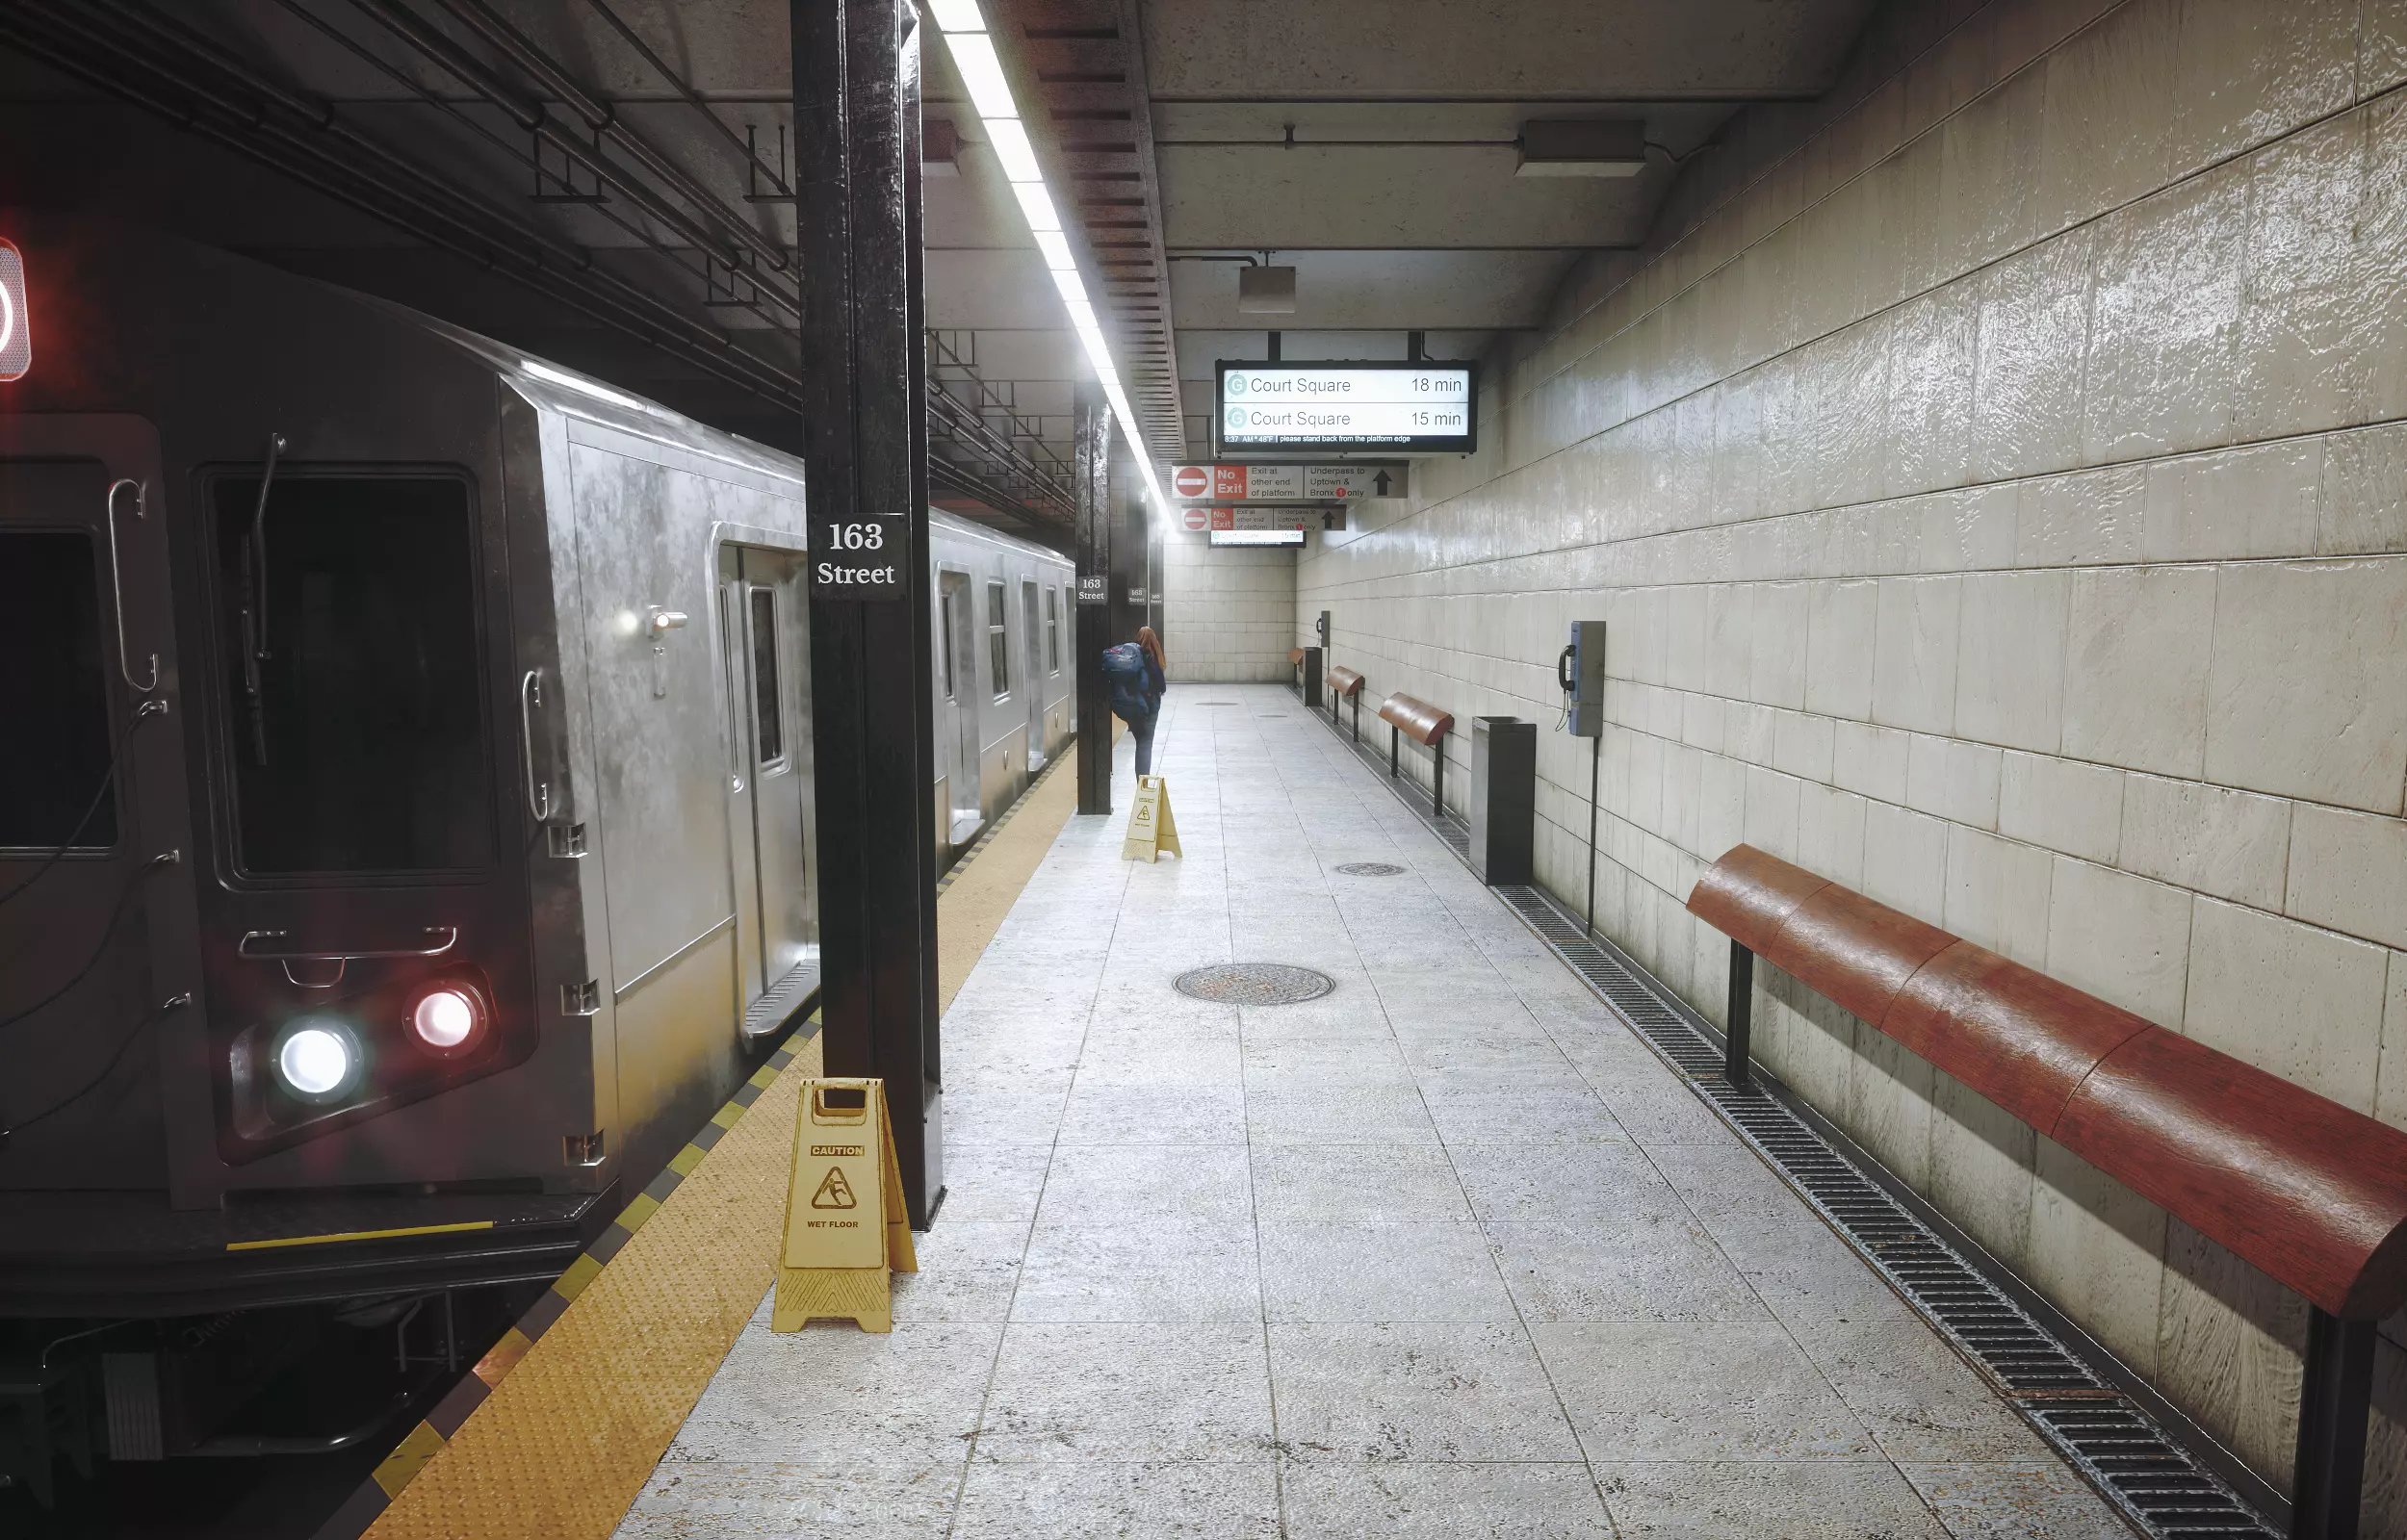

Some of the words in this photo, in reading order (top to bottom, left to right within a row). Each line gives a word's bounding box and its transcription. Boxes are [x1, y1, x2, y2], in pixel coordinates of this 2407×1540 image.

[1251, 378, 1292, 392] Court
[1297, 378, 1351, 395] Square
[1411, 377, 1429, 392] 18
[1435, 377, 1462, 392] min
[1251, 411, 1292, 425] Court
[1297, 411, 1351, 428] Square
[1411, 411, 1429, 425] 15
[1435, 411, 1461, 425] min
[1280, 435, 1302, 444] please
[1366, 435, 1393, 444] platform
[1393, 435, 1411, 444] edge
[1217, 469, 1235, 480] No
[1310, 467, 1355, 477] Underpass
[1310, 478, 1341, 488] Uptown
[1217, 483, 1243, 494] Exit
[1346, 489, 1364, 498] only
[1261, 489, 1296, 499] platform
[829, 524, 883, 550] 163
[817, 562, 895, 584] Street
[1083, 578, 1100, 589] 163
[1078, 591, 1104, 600] Street
[812, 1146, 864, 1155] CAUTION
